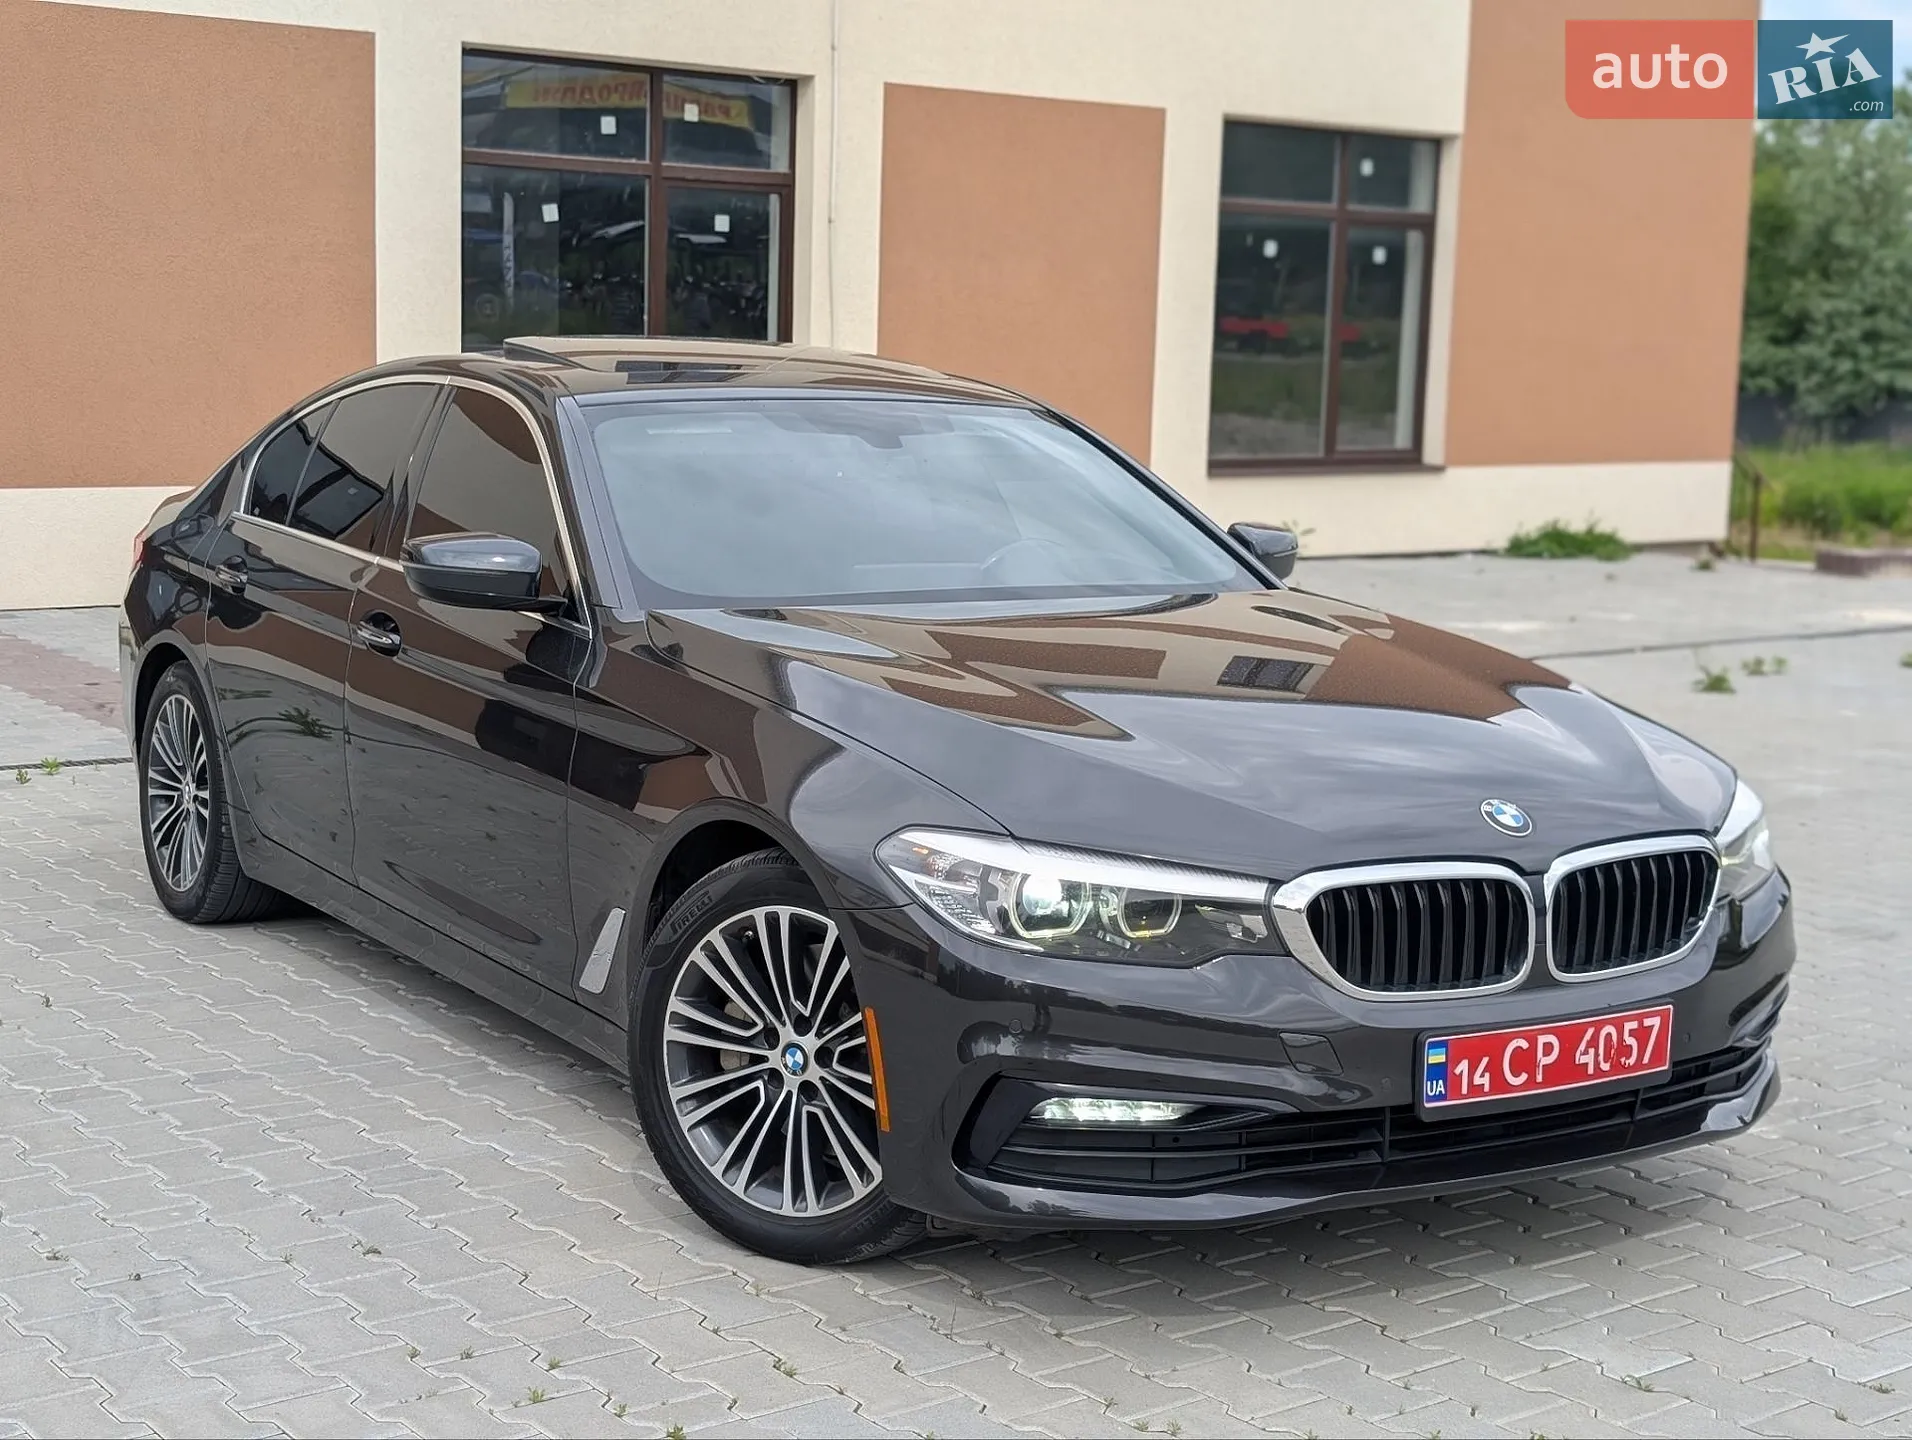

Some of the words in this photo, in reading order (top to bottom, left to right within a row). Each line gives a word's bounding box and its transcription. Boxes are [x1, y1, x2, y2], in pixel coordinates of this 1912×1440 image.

[1453, 1056, 1490, 1095] 14
[1502, 1034, 1560, 1086] CP
[1575, 1016, 1661, 1075] 4057
[1427, 1080, 1445, 1096] UA
